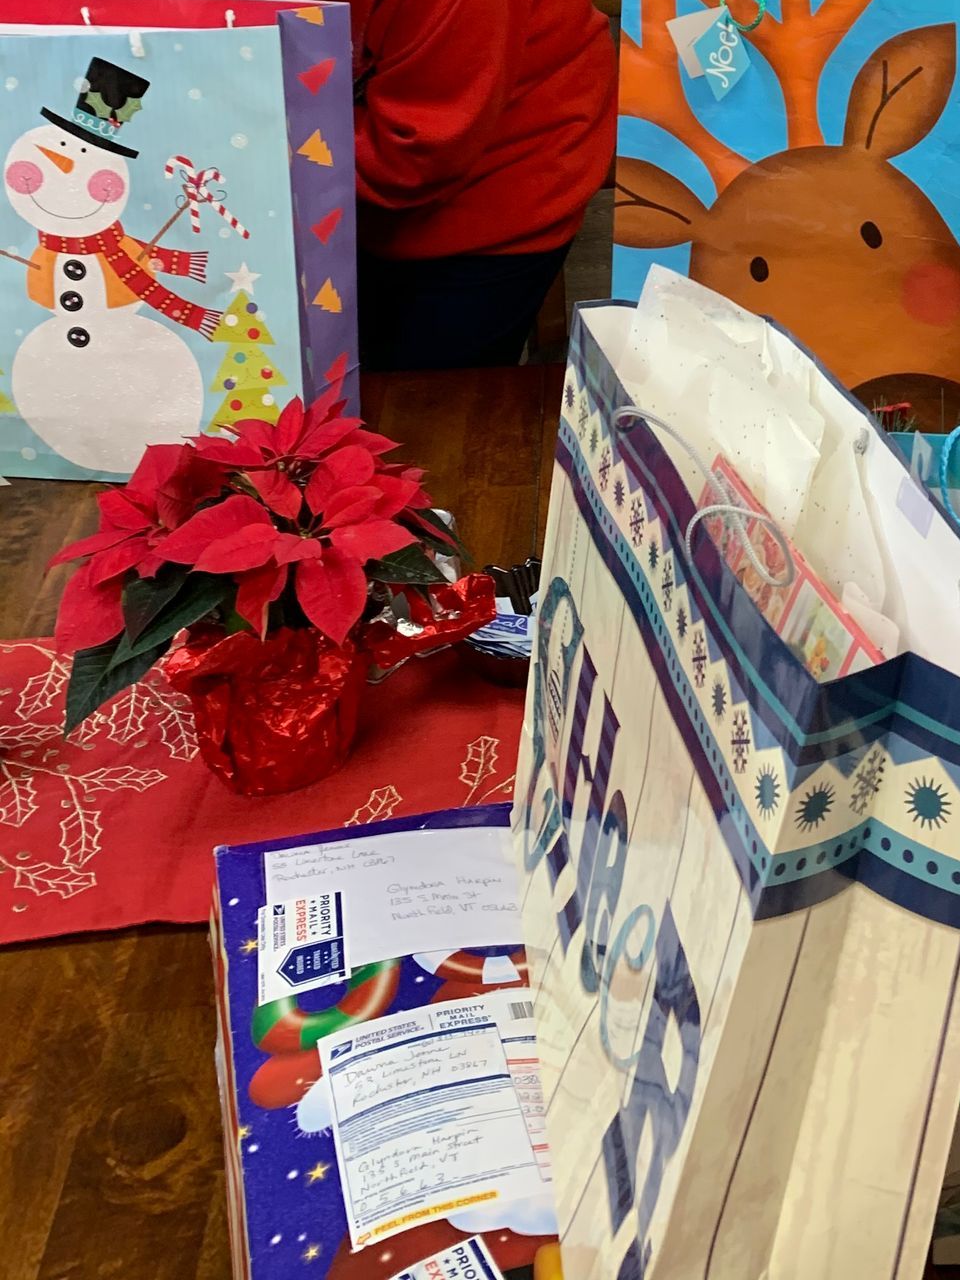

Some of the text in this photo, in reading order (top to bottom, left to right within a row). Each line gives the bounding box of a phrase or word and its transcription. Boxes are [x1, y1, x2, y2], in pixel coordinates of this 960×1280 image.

[296, 899, 307, 942] EXPRESS
[309, 906, 318, 929] MAIL
[320, 894, 331, 936] PRIORITY
[435, 1004, 486, 1018] PRIORITY
[439, 1016, 489, 1029] EXPRESS
[449, 1013, 476, 1021] MAIL
[354, 1036, 386, 1050] POSTAL
[355, 1020, 417, 1043] UNITED STATES
[374, 1218, 400, 1235] PEEL
[402, 1209, 431, 1223] FROM
[434, 1202, 455, 1213] THIS
[456, 1190, 498, 1207] CORNER
[452, 1246, 480, 1280] PRIO
